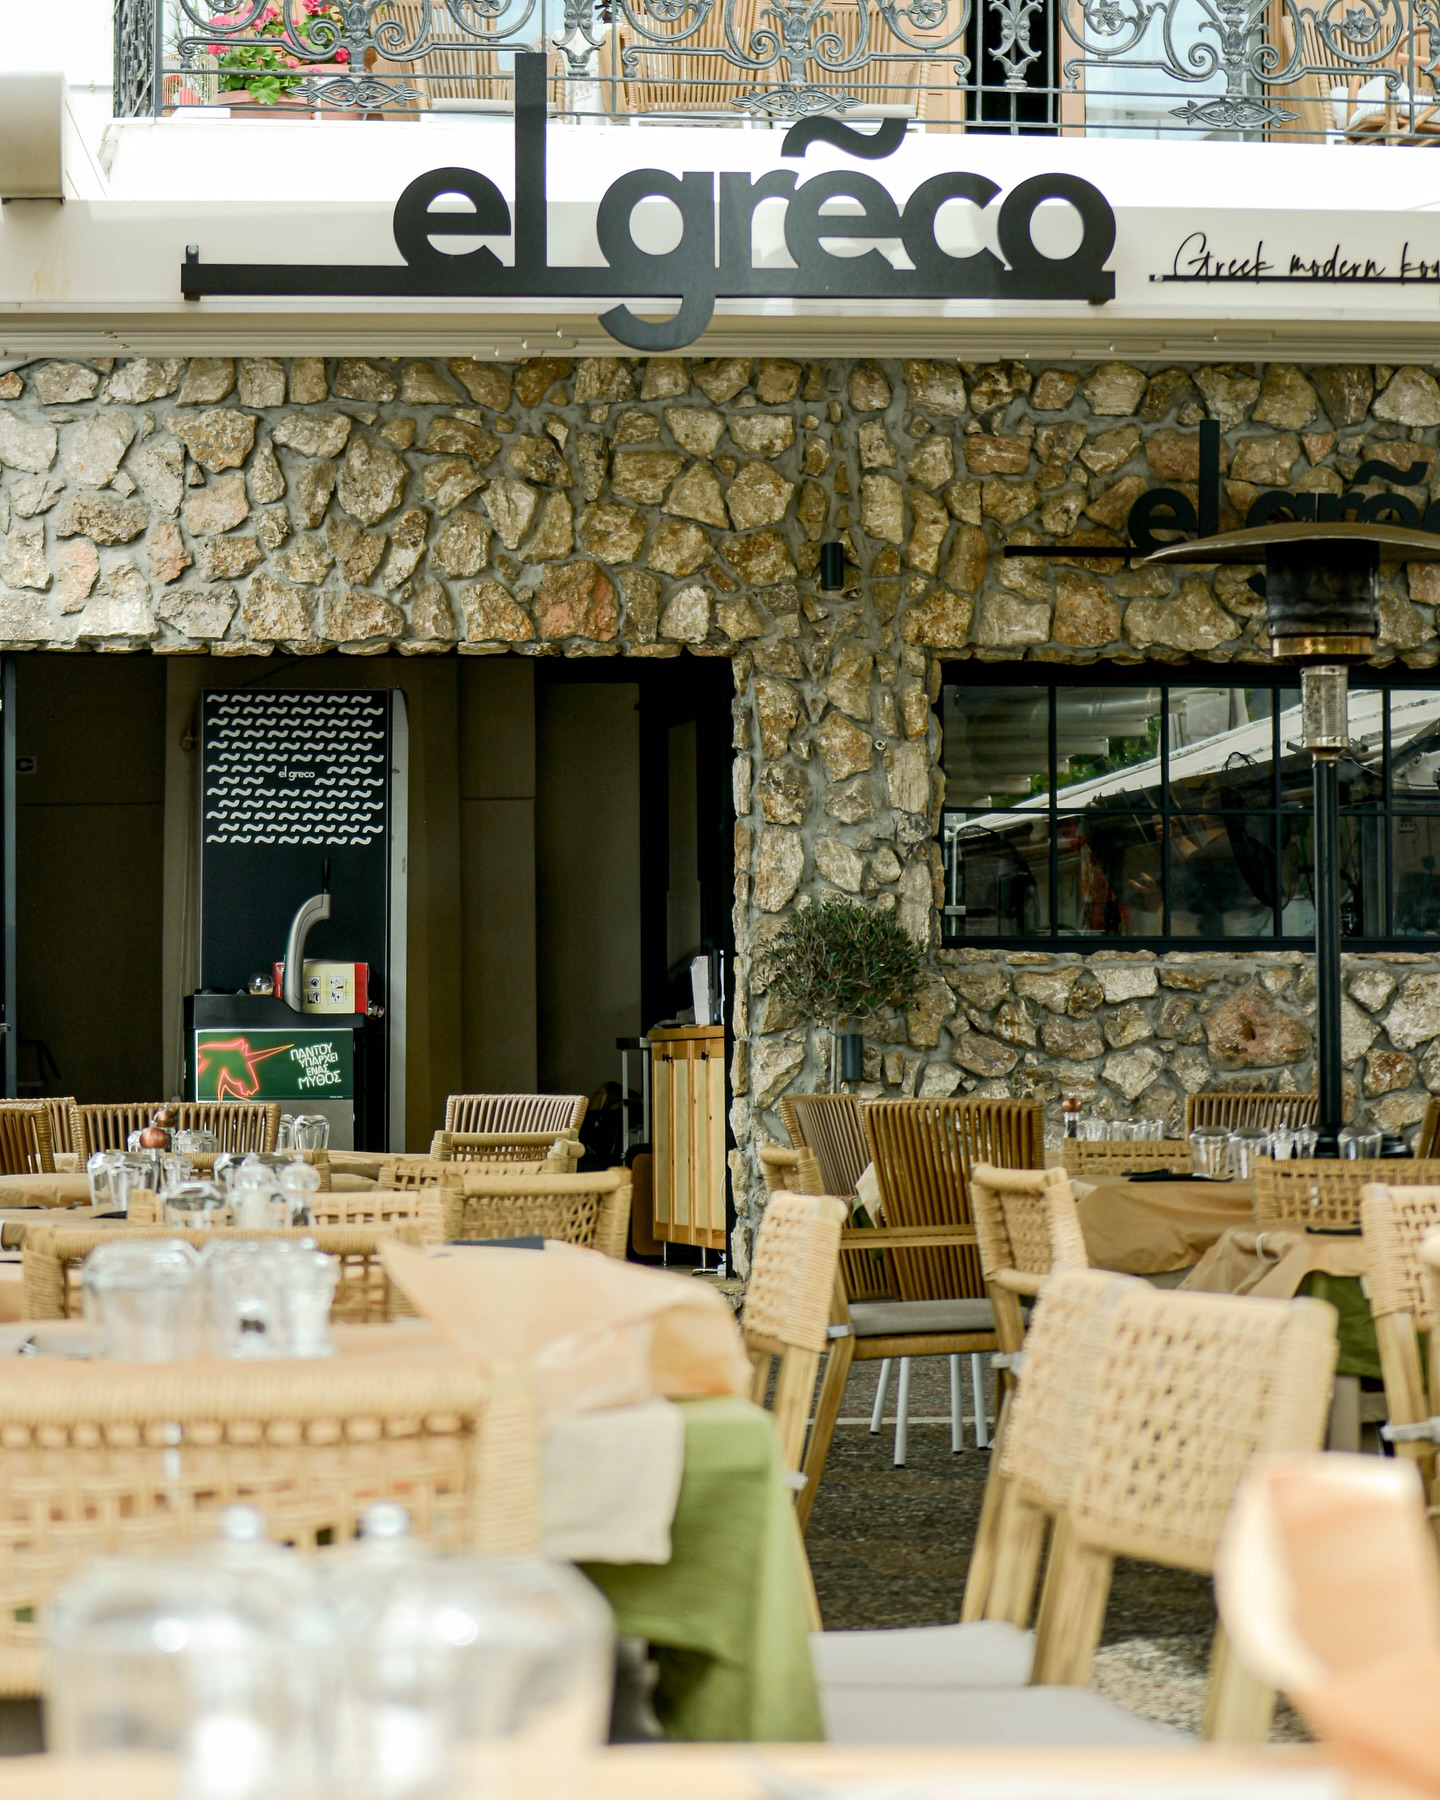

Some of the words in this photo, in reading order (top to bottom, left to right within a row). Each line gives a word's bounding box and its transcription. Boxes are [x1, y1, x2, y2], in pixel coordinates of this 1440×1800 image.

[393, 53, 547, 292] el
[1173, 231, 1274, 282] Greek
[1289, 244, 1386, 281] modern
[278, 765, 287, 778] el
[288, 771, 315, 781] greco
[290, 1042, 333, 1061] ΠΑΝΤΟΥ
[298, 1052, 339, 1068] ΥΠΑΡΧΕΙ
[298, 1069, 342, 1090] ΜΥΘΟΣ
